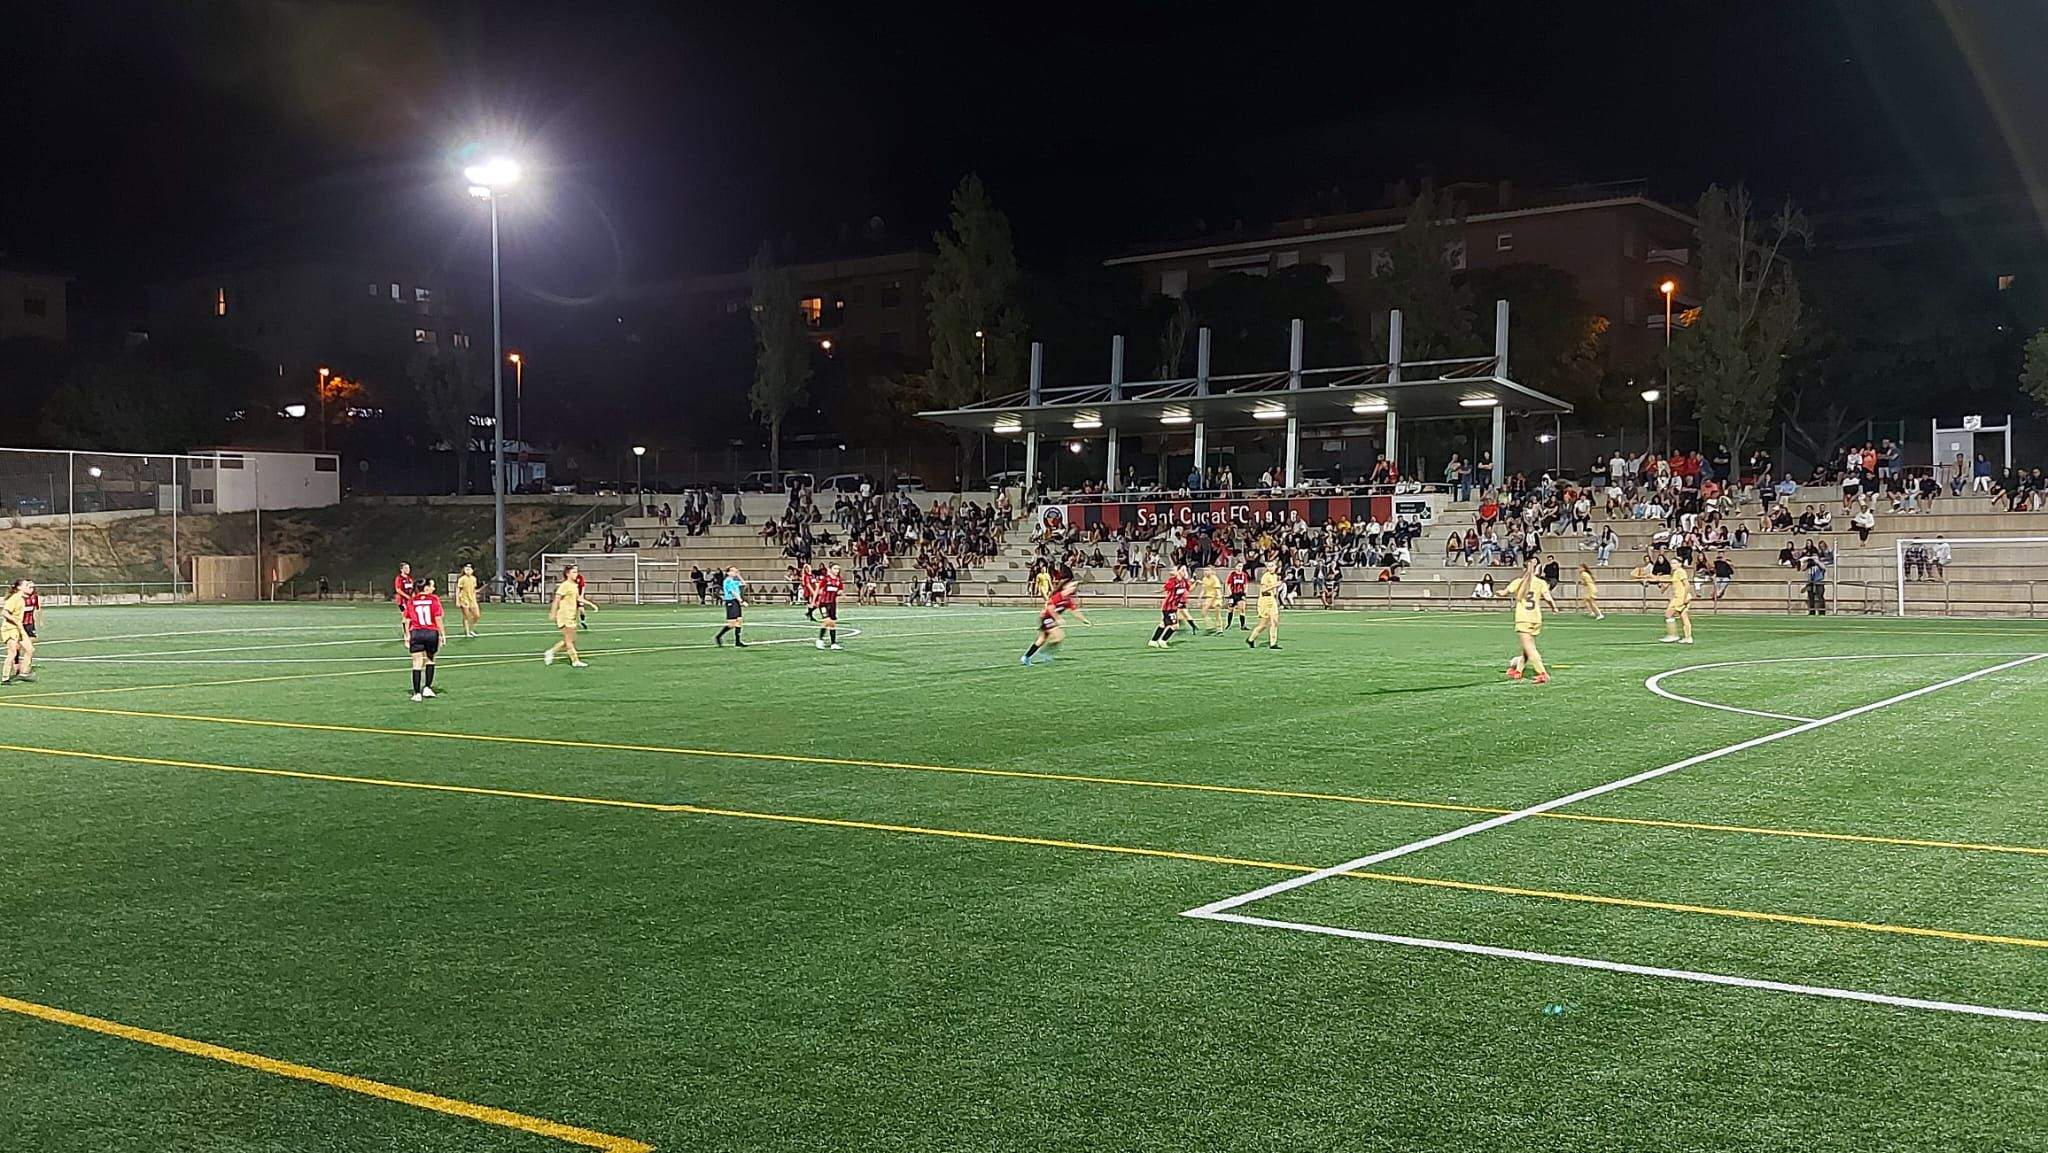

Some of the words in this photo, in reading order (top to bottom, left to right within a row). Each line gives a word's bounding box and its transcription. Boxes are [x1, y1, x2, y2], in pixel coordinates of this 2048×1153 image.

[1137, 508, 1174, 526] Sant
[1230, 505, 1249, 524] FC
[1525, 591, 1536, 610] 3
[415, 605, 432, 625] 11
